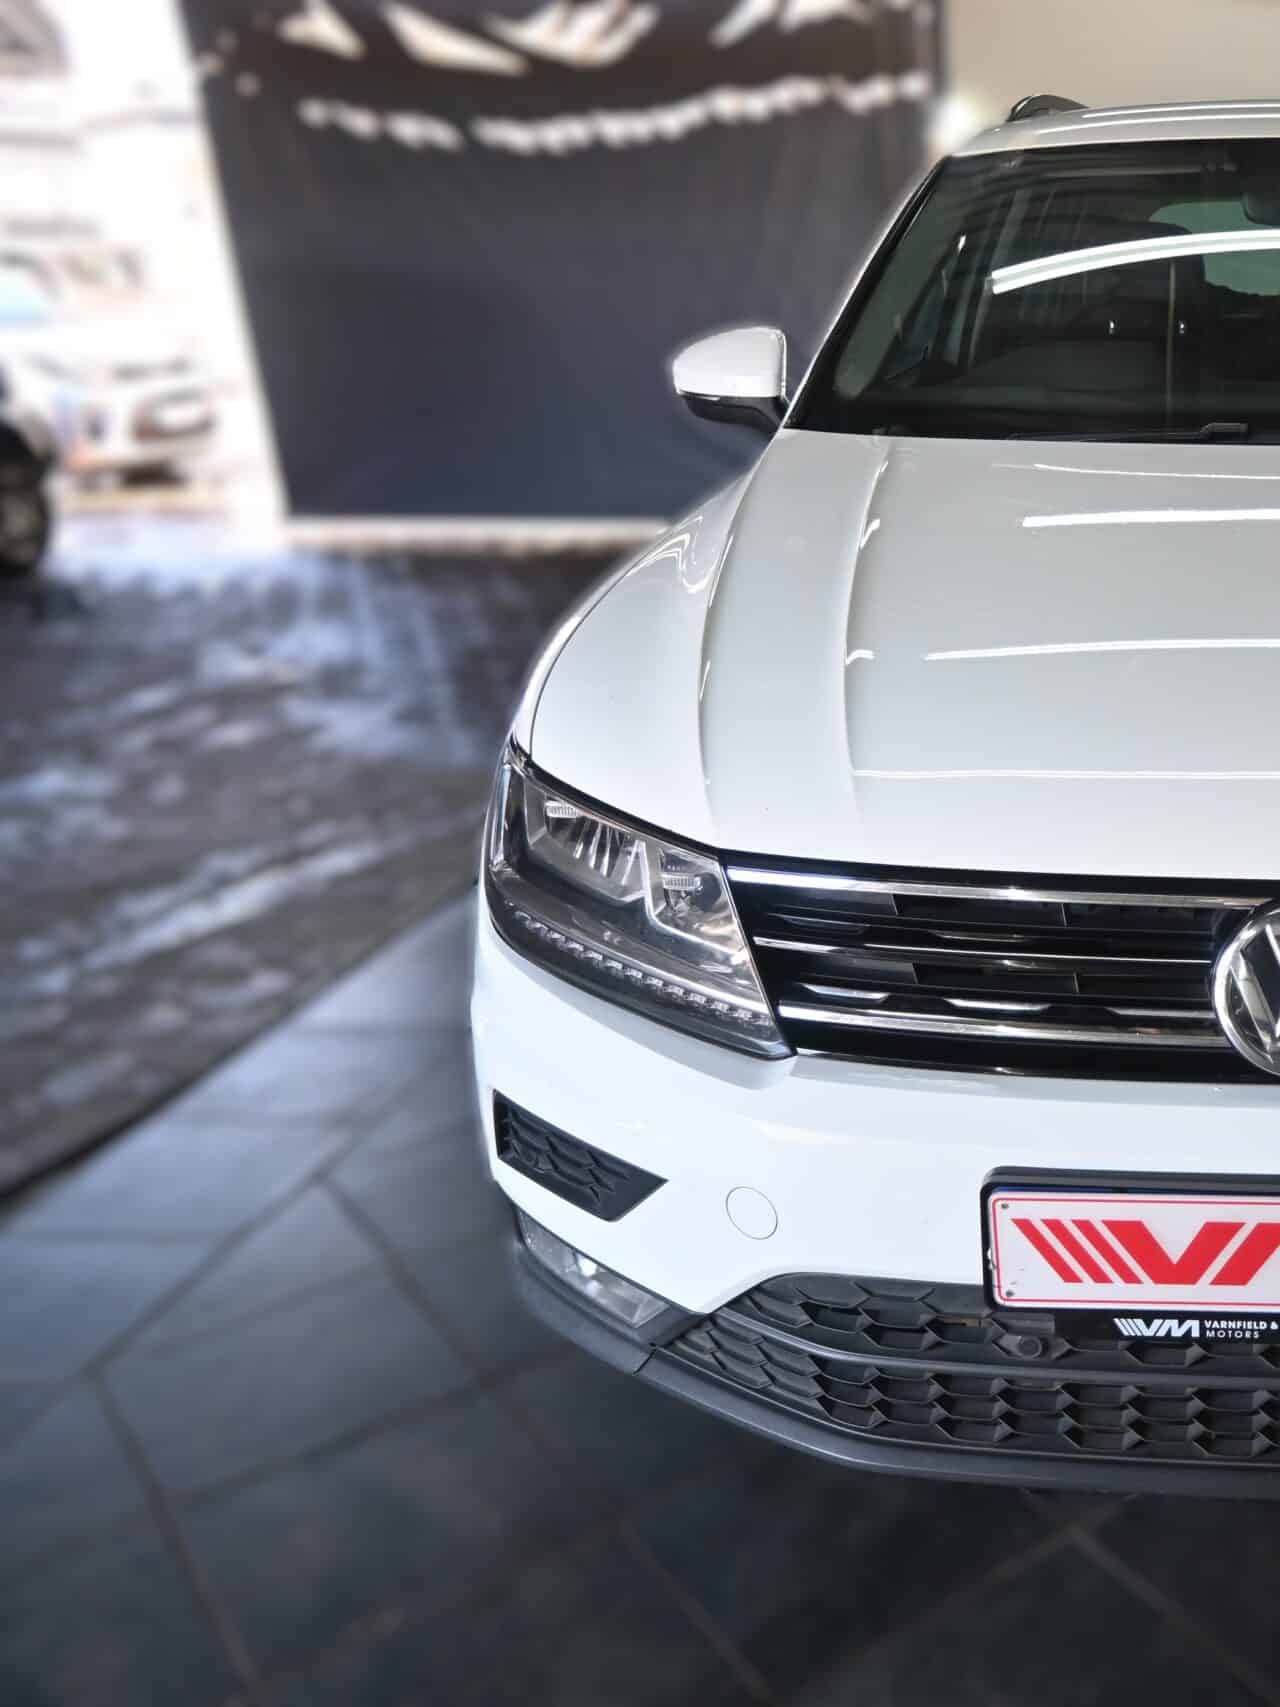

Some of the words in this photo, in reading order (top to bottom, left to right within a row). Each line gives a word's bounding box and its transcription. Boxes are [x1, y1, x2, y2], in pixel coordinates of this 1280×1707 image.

[1204, 1319, 1267, 1330] VARNFIELD
[1270, 1321, 1279, 1331] &
[1206, 1329, 1260, 1339] MOTORS
